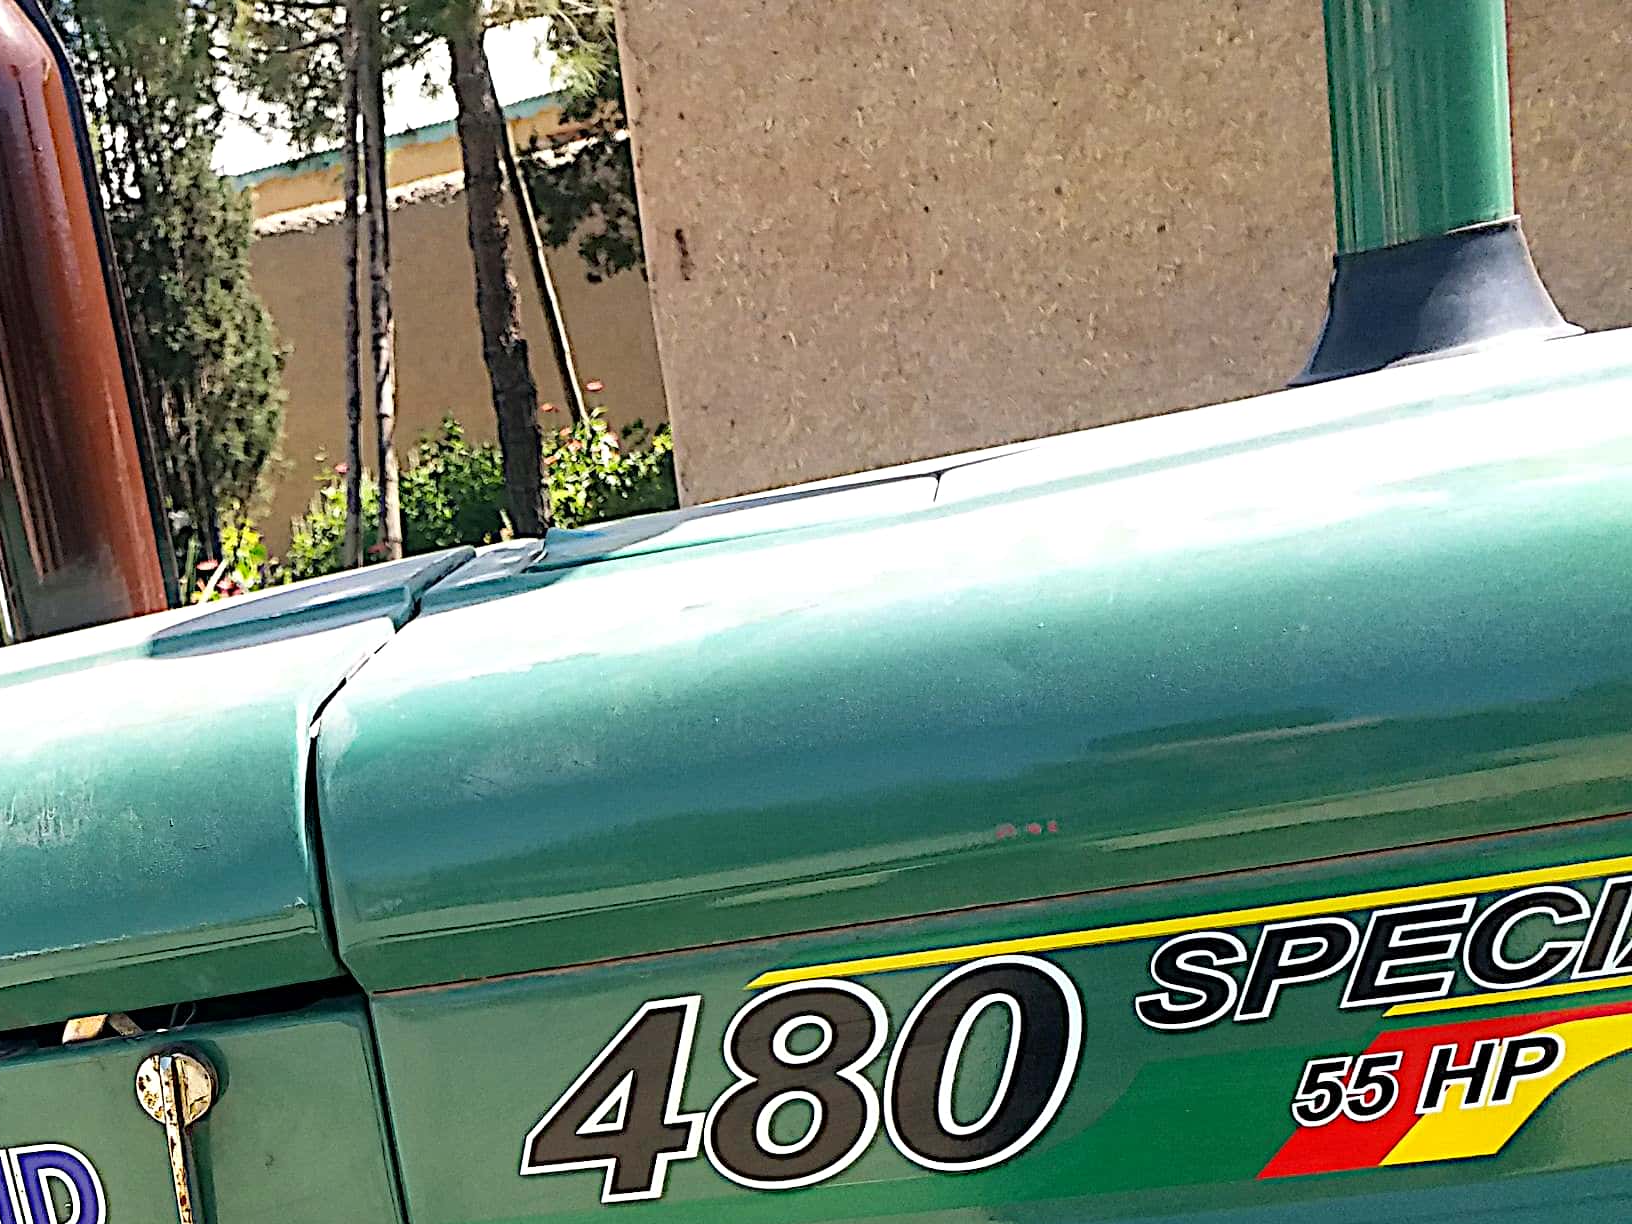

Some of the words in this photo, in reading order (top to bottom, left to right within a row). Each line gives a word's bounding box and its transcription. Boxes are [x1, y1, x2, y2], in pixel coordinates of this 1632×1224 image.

[1135, 875, 1632, 1030] SPECI
[519, 954, 1083, 1204] 480
[1291, 1050, 1403, 1127] 55
[1415, 1033, 1566, 1115] HP
